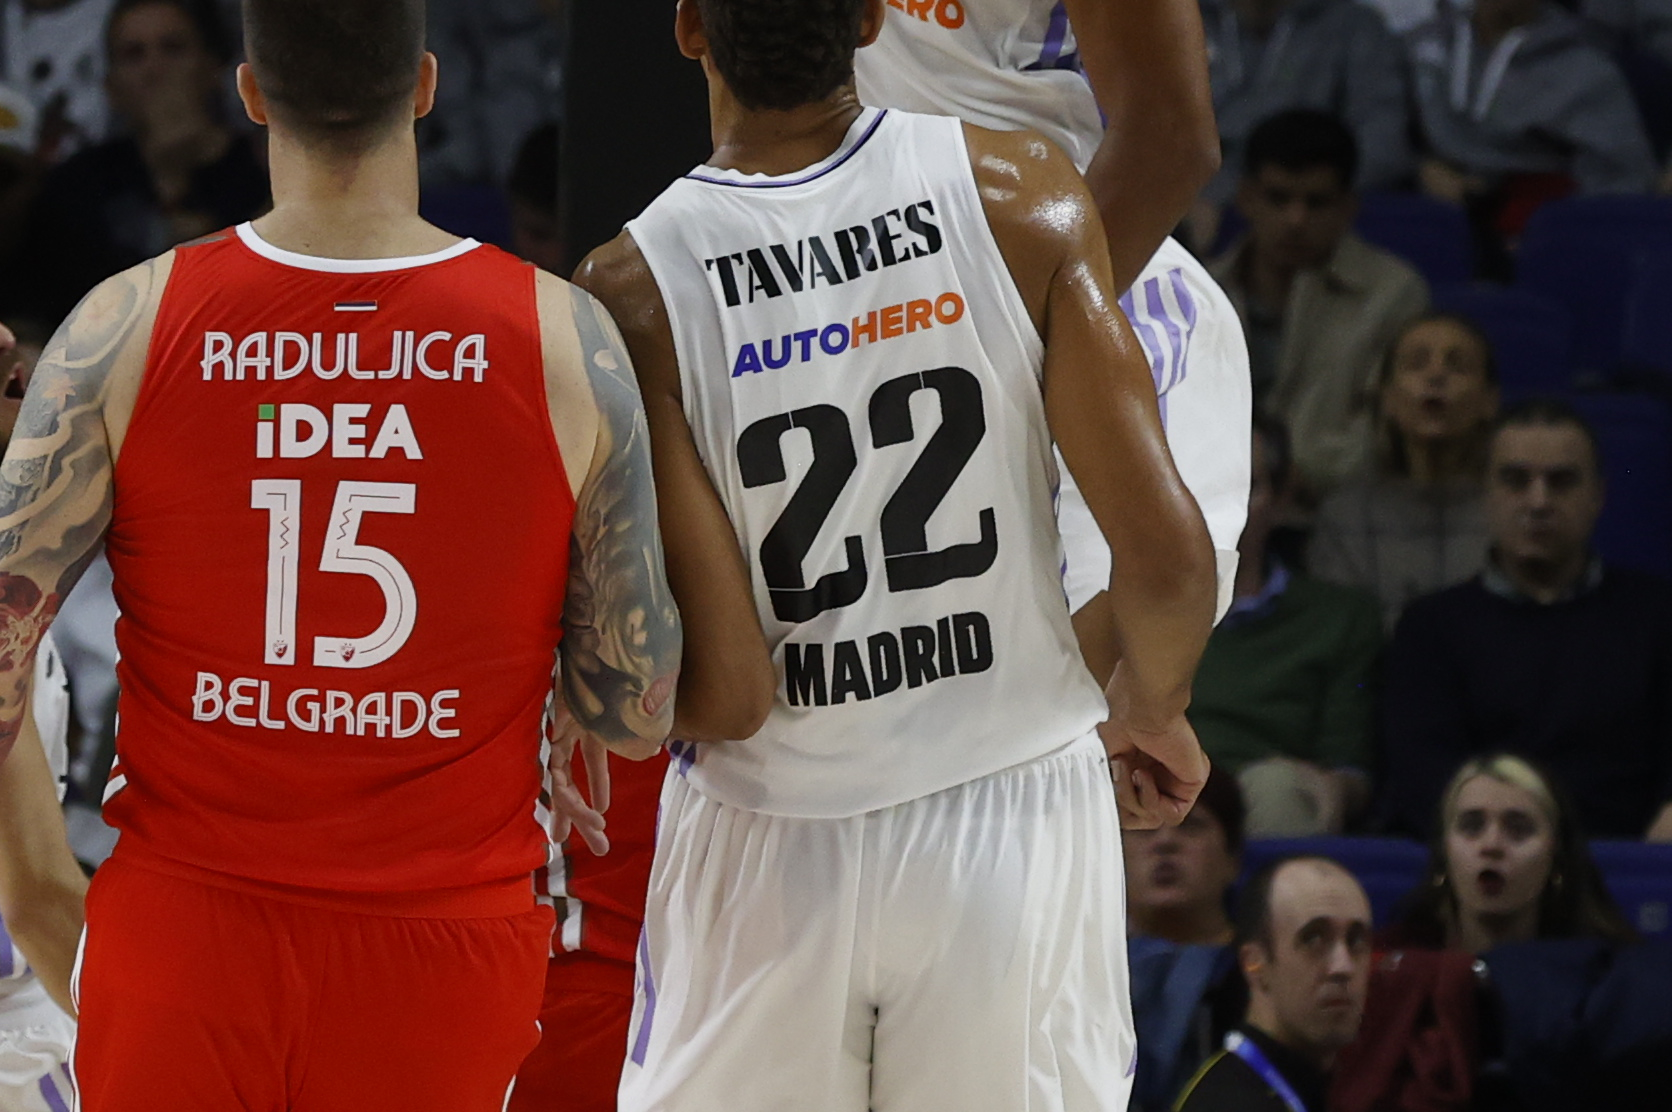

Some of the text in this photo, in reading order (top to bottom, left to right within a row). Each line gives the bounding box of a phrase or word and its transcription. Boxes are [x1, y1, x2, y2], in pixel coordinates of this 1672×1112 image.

[705, 199, 943, 307] TAVARES
[200, 330, 489, 383] RADULJICA
[731, 292, 965, 378] AUTOHERO
[736, 366, 999, 623] 22
[250, 478, 417, 669] 15
[191, 671, 461, 739] BELGRADE
[784, 611, 994, 707] MADRID
